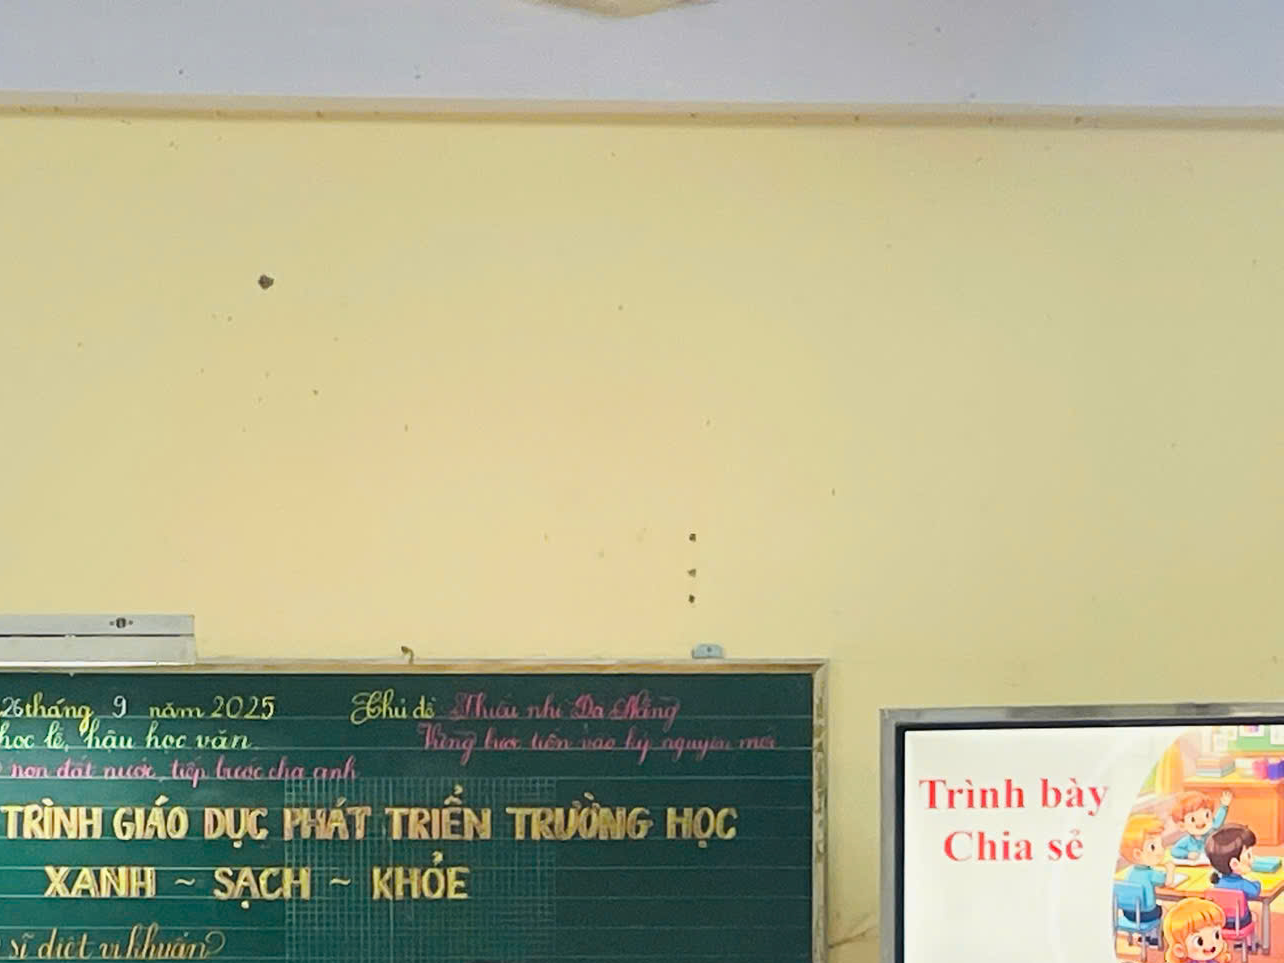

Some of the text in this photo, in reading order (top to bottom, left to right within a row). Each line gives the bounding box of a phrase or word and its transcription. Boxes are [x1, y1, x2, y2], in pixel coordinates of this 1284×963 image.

[24, 691, 94, 735] tháng
[112, 696, 128, 719] 9
[148, 703, 205, 719] năm
[211, 696, 276, 720] 2025
[83, 719, 134, 753] hậu
[145, 721, 187, 754] học
[196, 729, 253, 749] văn
[268, 754, 305, 780] cha
[312, 754, 358, 780] anh
[919, 778, 1109, 816] Trình bày
[0, 797, 103, 840] TRÌNH
[112, 795, 189, 840] GIÁO
[203, 805, 269, 849] DỤC
[282, 797, 372, 841] PHÁT
[384, 784, 492, 841] TRIỂN
[506, 791, 654, 841] TRƯỜNG
[666, 806, 737, 848] HỌC
[943, 829, 1084, 861] Chia sẻ
[43, 865, 157, 899] XANH
[213, 866, 311, 909] SẠCH
[372, 851, 471, 900] KHỎE
